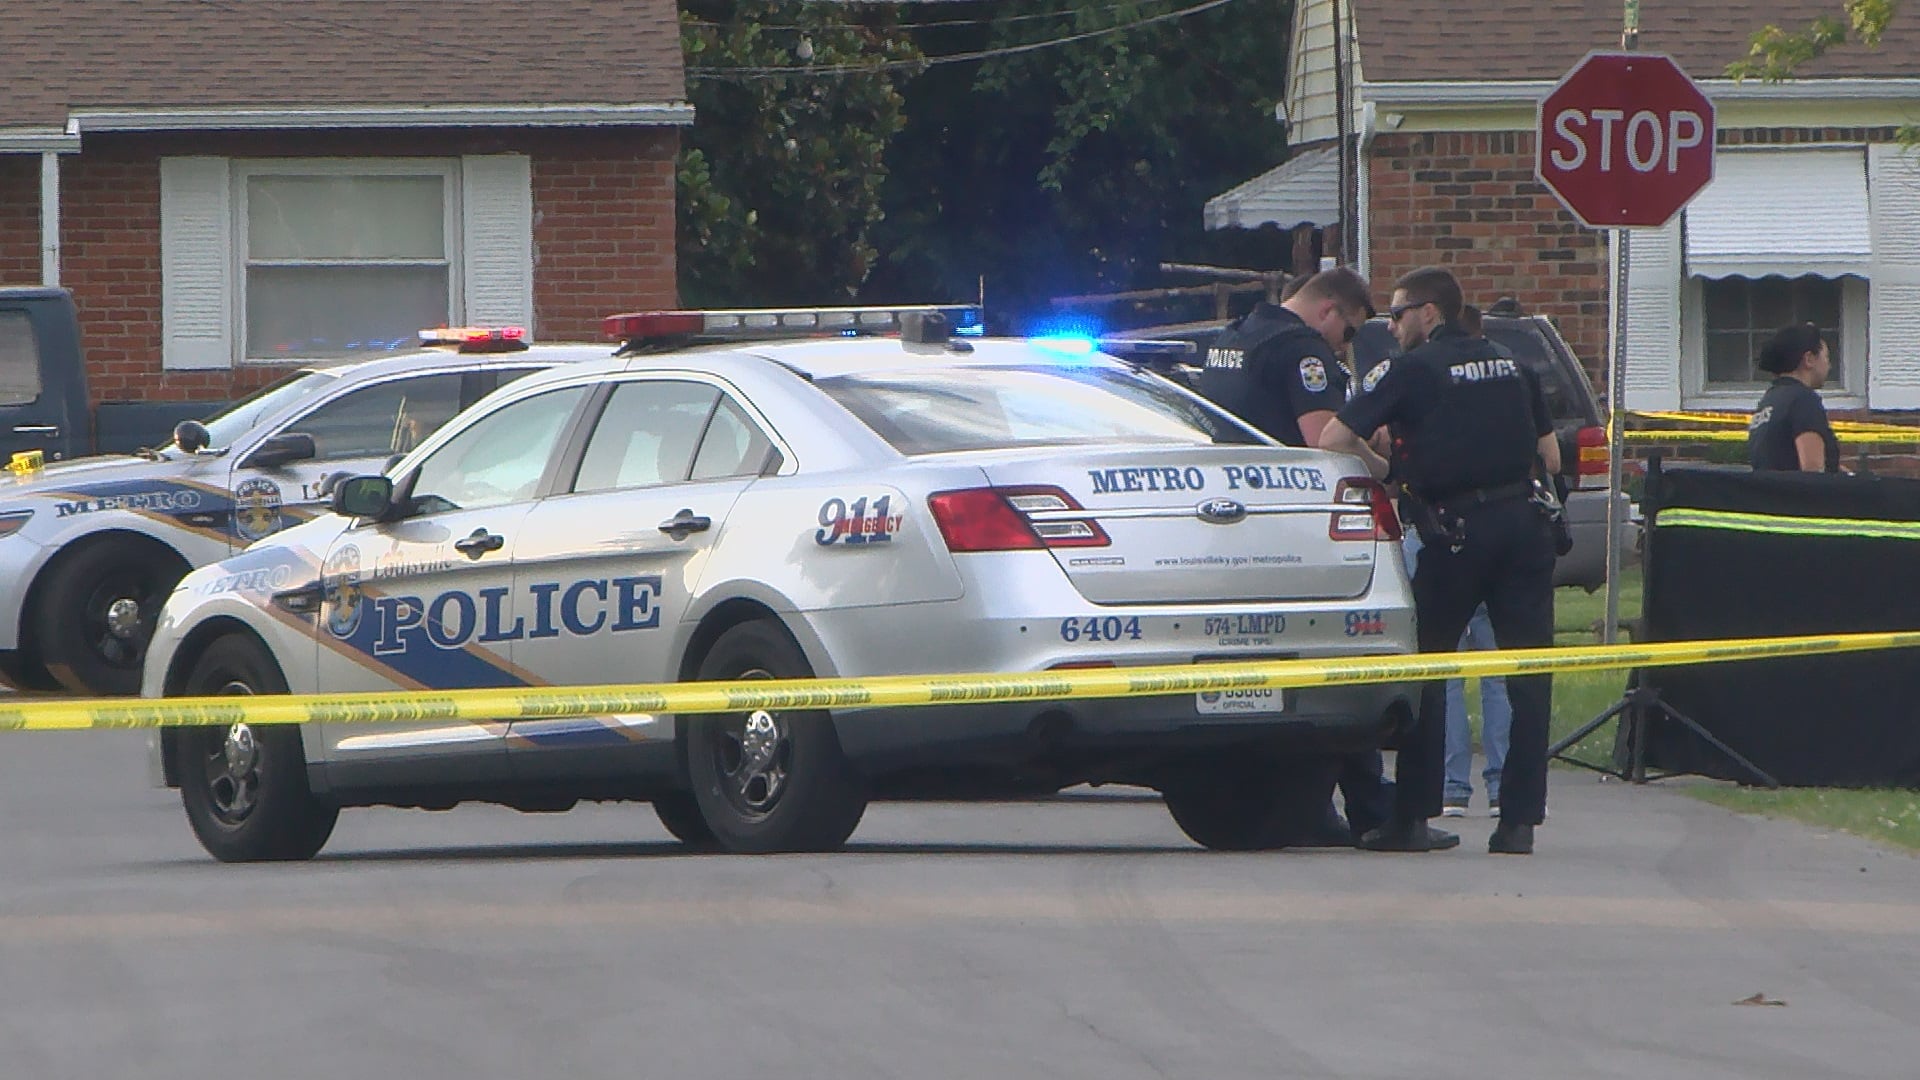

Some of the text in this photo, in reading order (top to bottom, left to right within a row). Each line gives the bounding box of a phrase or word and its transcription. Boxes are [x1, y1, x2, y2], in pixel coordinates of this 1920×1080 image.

[1551, 109, 1704, 173] STOP
[1206, 348, 1245, 369] POLICE
[1449, 359, 1519, 384] POLICE
[1088, 466, 1326, 494] METRO POLICE
[54, 490, 201, 518] METRO
[815, 495, 891, 545] 911
[193, 564, 291, 598] METRO
[374, 574, 663, 655] POLICE
[1204, 615, 1286, 636] 574-LMPD
[1344, 609, 1384, 637] 911
[1060, 616, 1143, 642] 6404
[1222, 700, 1256, 710] OFFICIAL
